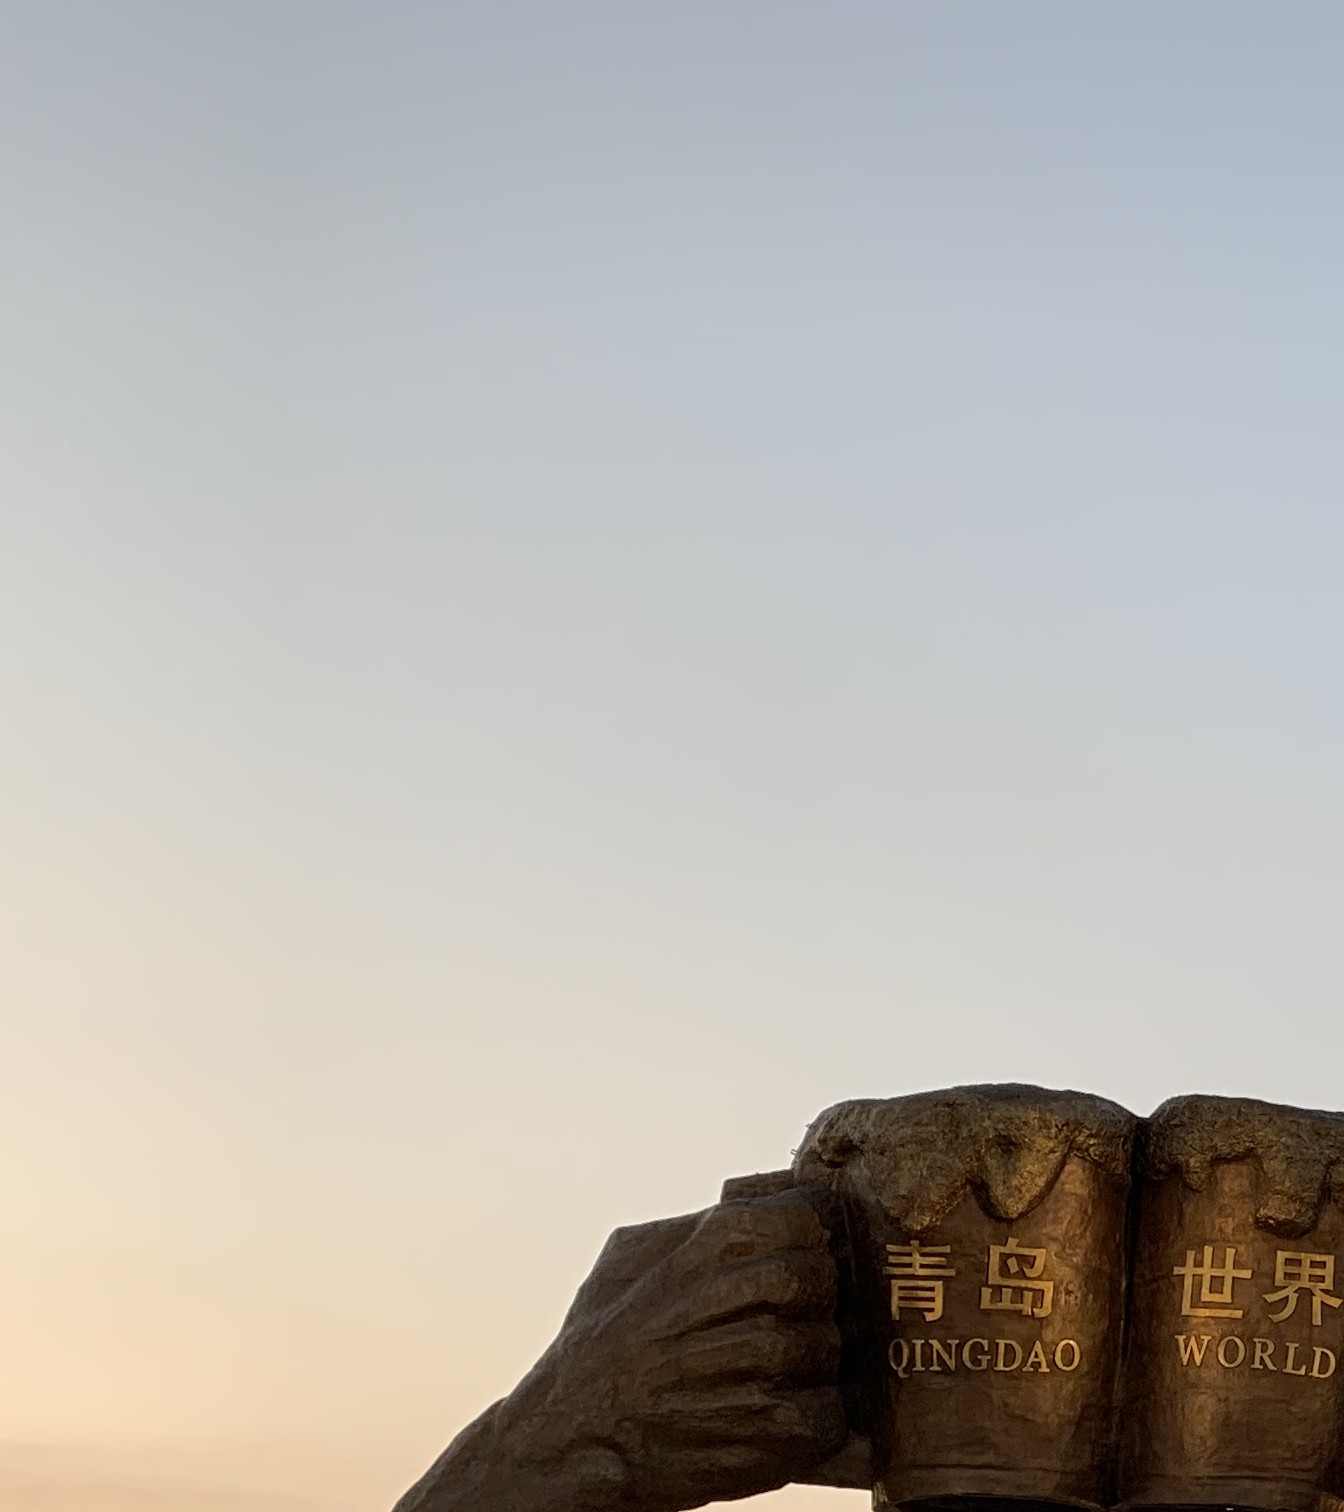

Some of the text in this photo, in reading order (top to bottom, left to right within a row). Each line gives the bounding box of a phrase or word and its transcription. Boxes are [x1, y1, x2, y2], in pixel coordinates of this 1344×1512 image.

[883, 1238, 1055, 1322] 青岛
[1173, 1244, 1344, 1326] 世界
[890, 1338, 1081, 1379] QINGDAO
[1174, 1334, 1336, 1379] WORLD
